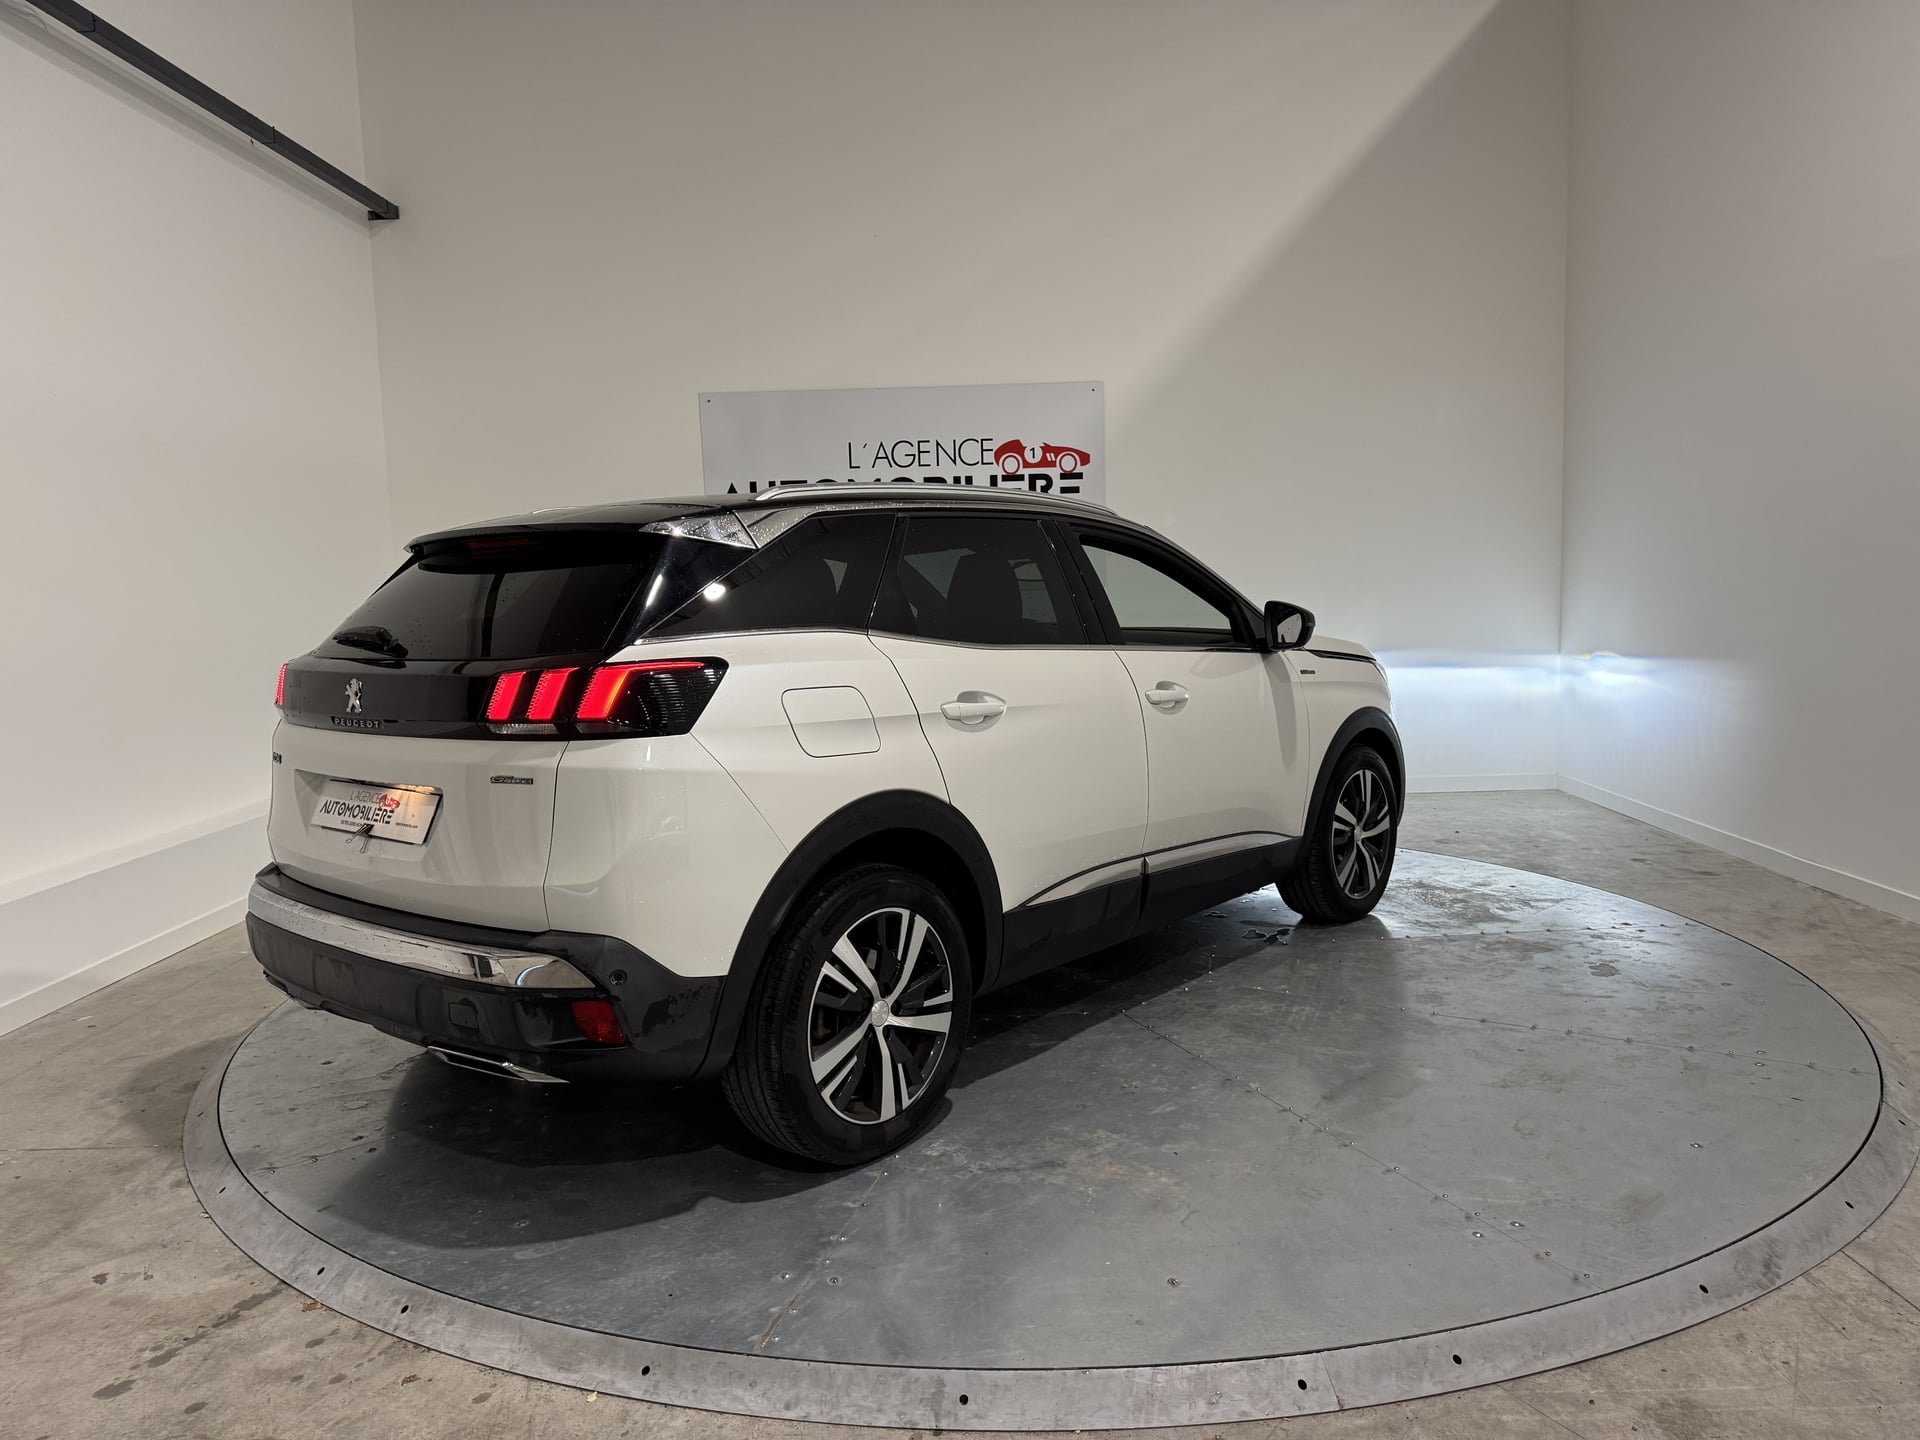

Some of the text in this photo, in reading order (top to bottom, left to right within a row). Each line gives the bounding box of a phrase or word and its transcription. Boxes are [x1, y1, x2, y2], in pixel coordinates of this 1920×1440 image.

[847, 438, 994, 469] L'AGENCE
[333, 717, 381, 729] PEUGEOT
[319, 799, 395, 825] AUTOMOBILIERE
